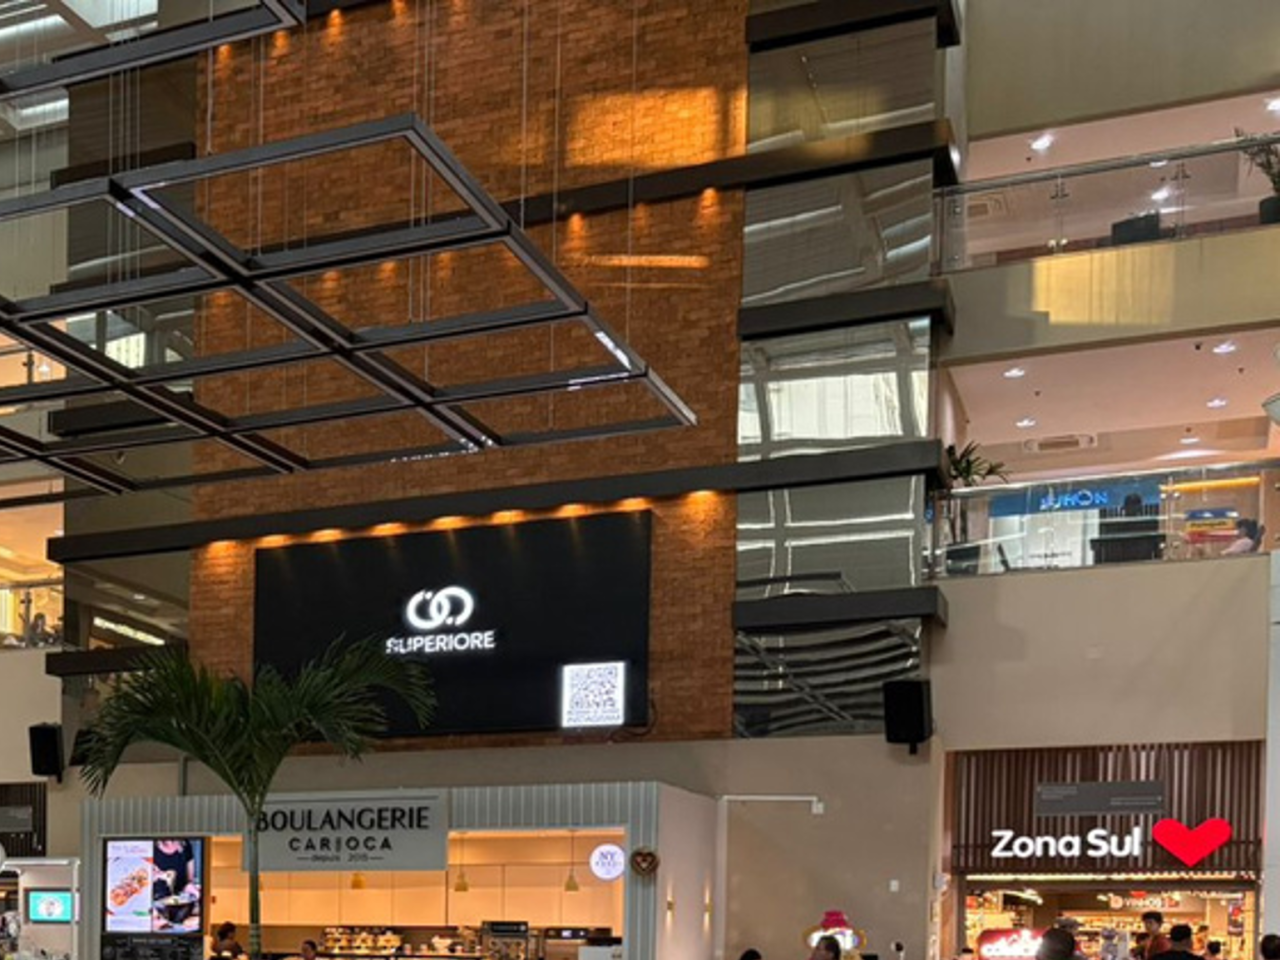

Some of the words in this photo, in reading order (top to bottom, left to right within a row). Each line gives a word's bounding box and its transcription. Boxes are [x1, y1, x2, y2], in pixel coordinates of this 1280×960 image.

[385, 630, 496, 654] SUPERIORE
[256, 806, 430, 832] BOULANGERIE
[288, 836, 392, 853] CARIOCA
[990, 829, 1079, 858] Zona
[1086, 826, 1142, 858] Sul
